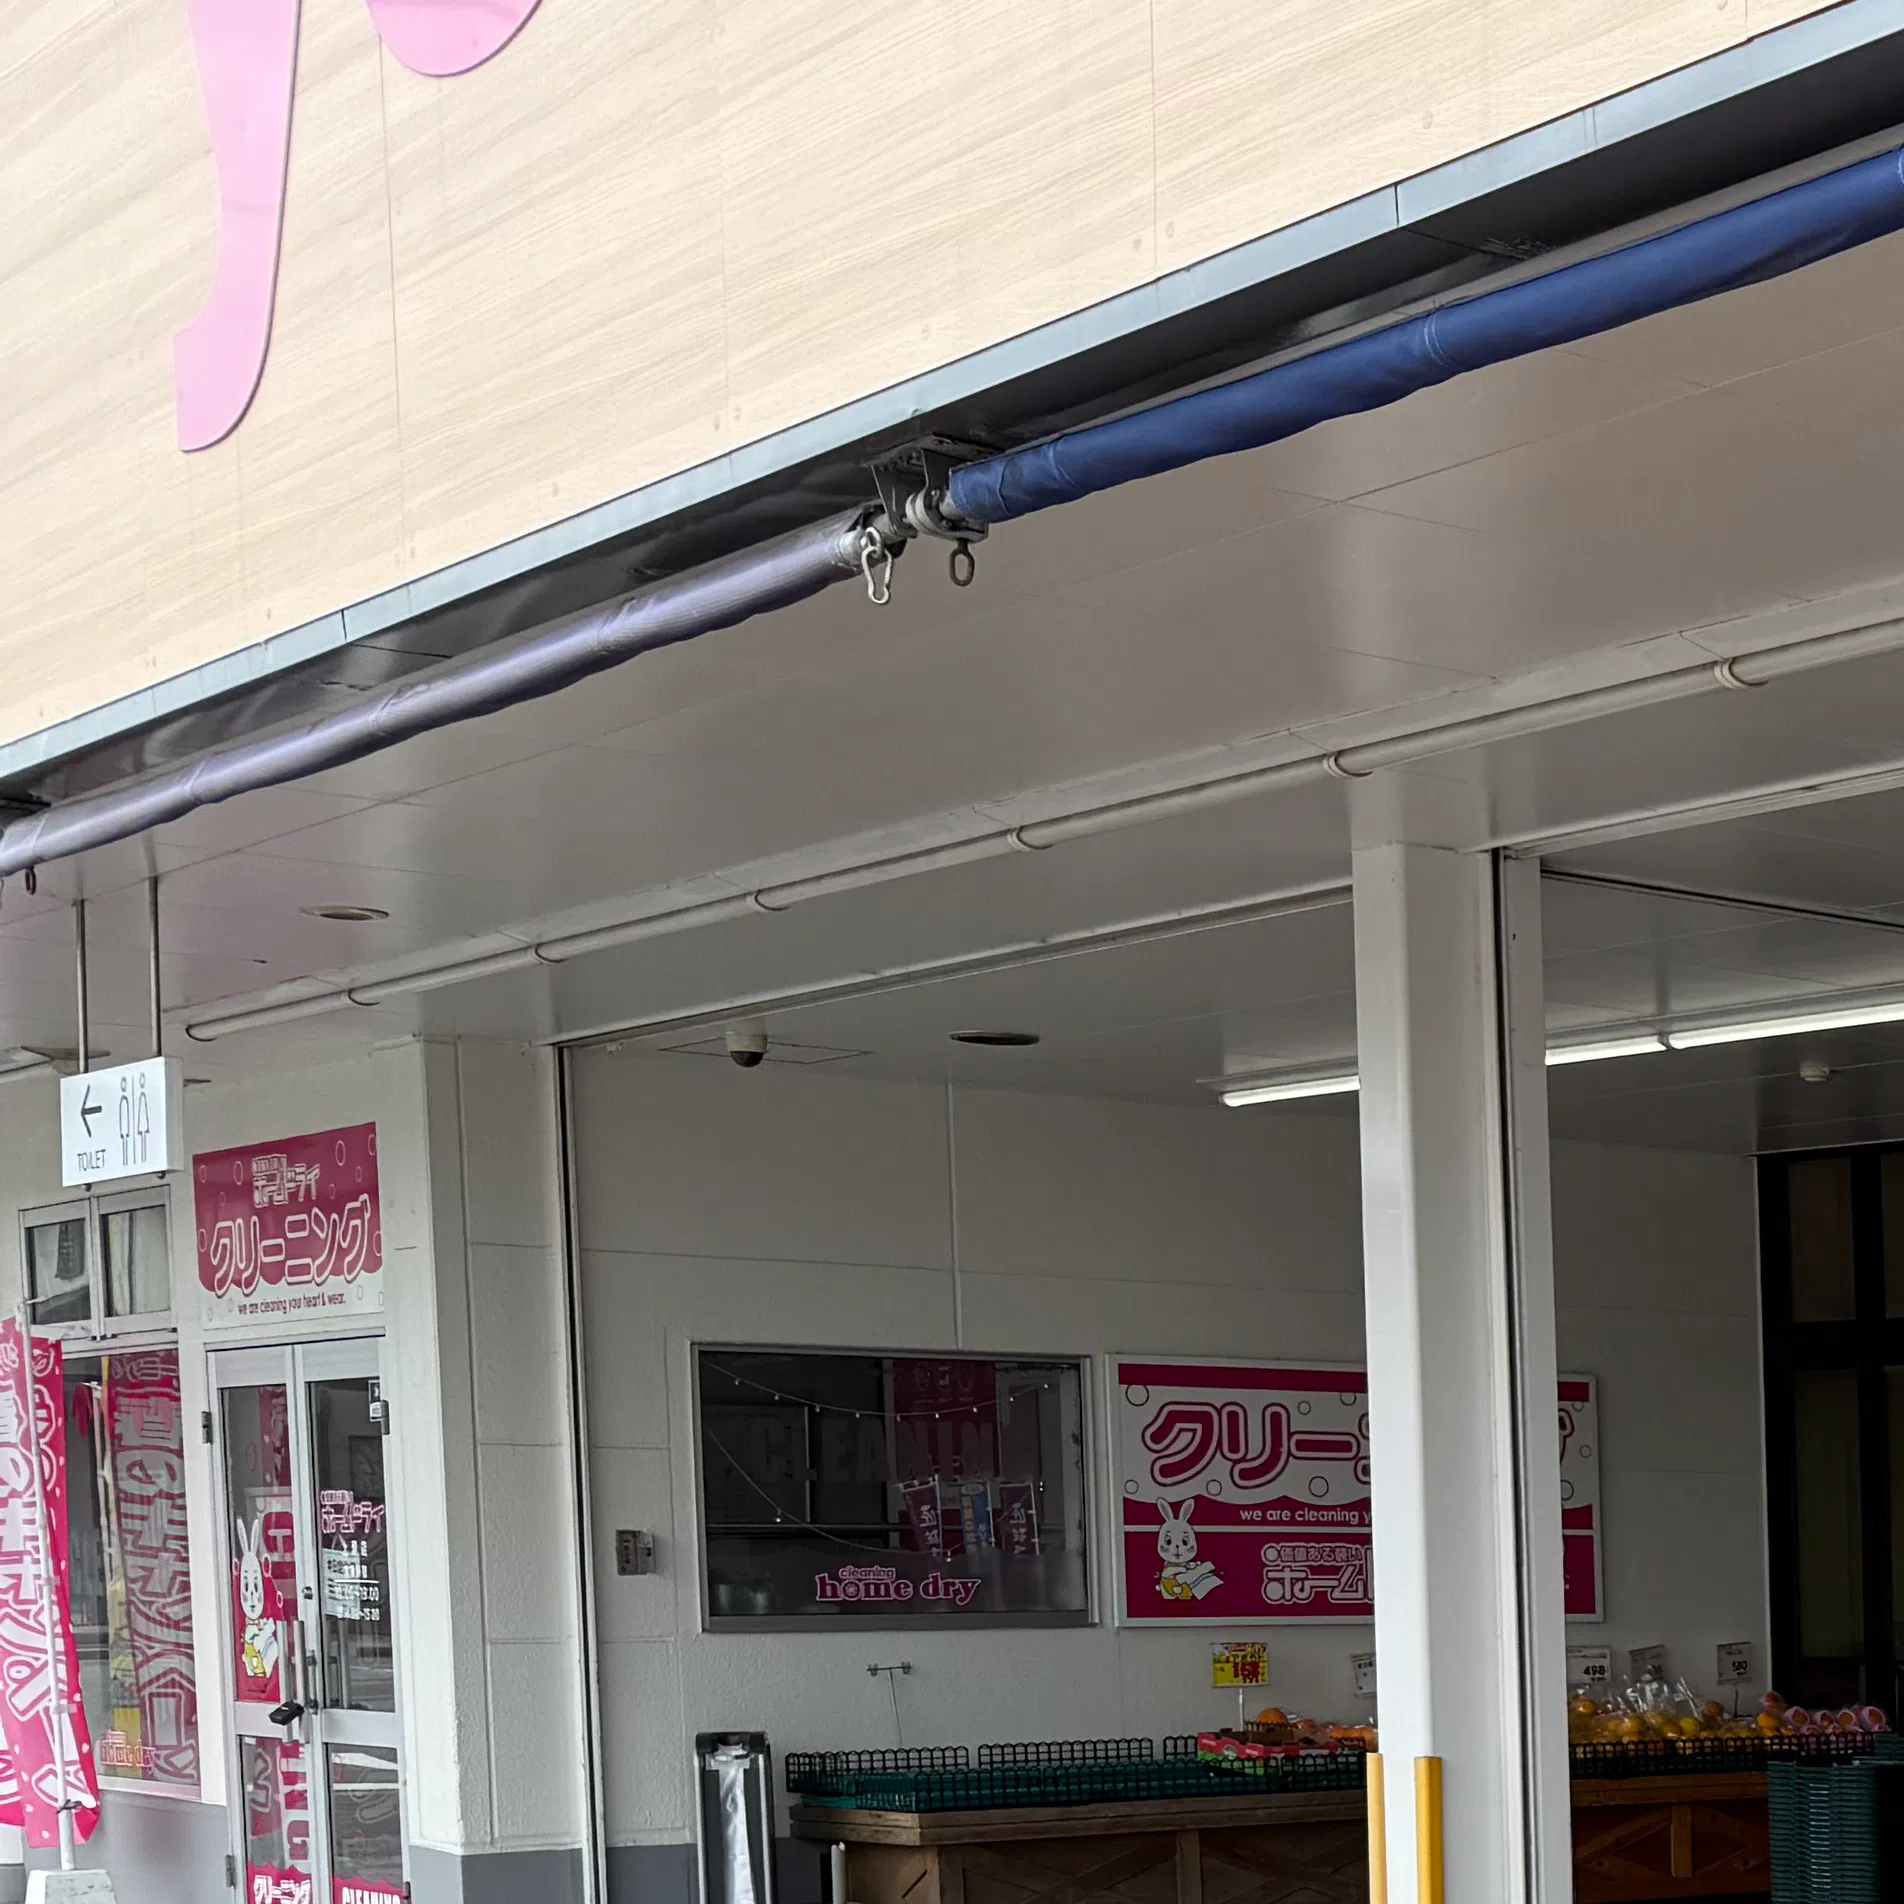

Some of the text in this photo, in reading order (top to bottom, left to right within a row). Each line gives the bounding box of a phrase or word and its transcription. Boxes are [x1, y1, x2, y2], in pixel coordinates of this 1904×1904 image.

[77, 1149, 106, 1171] TOILET
[210, 1193, 370, 1298] クリーニング
[1240, 1510, 1262, 1520] we
[1267, 1510, 1290, 1520] are
[1295, 1508, 1358, 1524] cleaning
[838, 1566, 895, 1579] cleaning
[1266, 1565, 1372, 1602] ホーム
[815, 1573, 981, 1605] home dry
